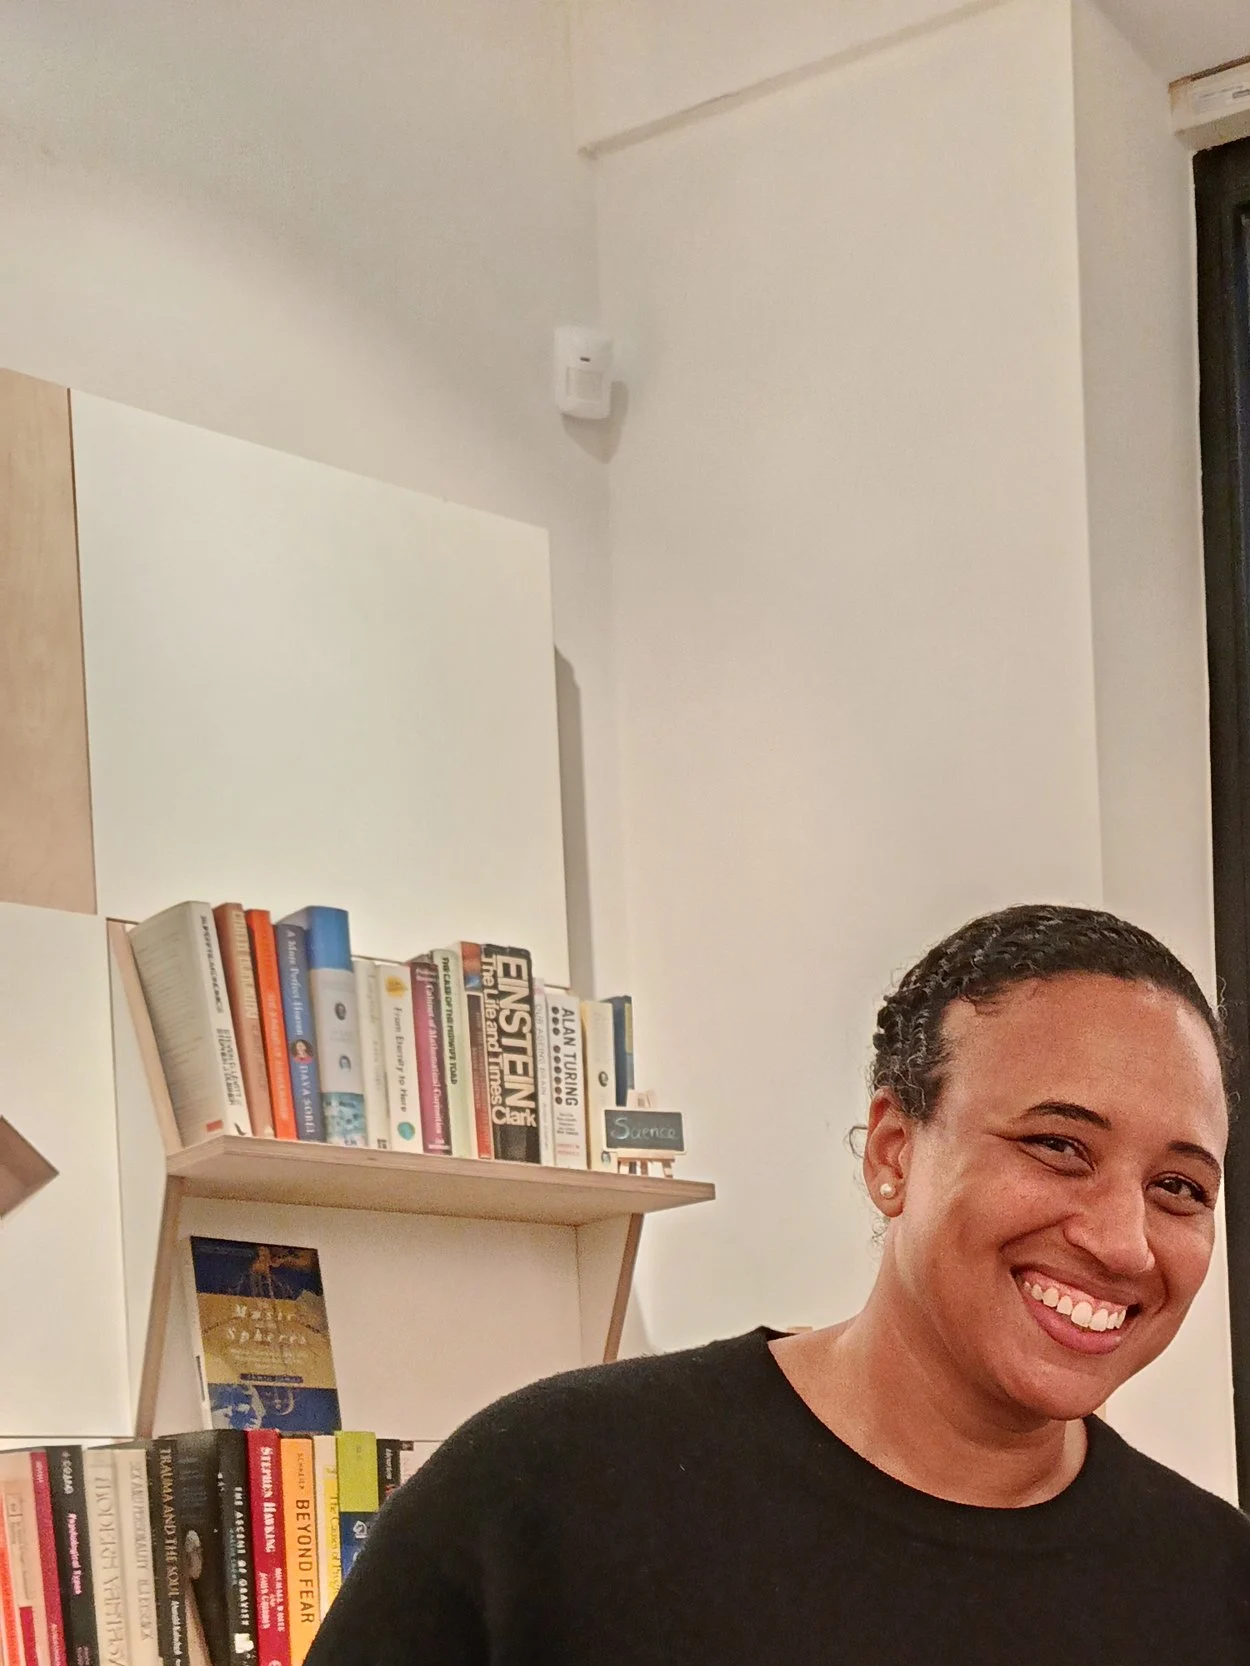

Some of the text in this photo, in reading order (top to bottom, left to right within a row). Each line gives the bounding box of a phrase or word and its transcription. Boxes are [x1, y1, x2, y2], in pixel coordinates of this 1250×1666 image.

[442, 957, 450, 972] THE
[443, 973, 452, 995] CASE
[445, 996, 453, 1008] OF
[393, 1007, 404, 1033] From
[481, 952, 504, 1105] The Life and Times
[497, 953, 536, 1109] EINSTEIN
[561, 1008, 577, 1047] ALAN
[395, 1036, 408, 1073] Eternity
[300, 1065, 312, 1096] DAVA
[399, 1075, 408, 1086] to
[564, 1053, 579, 1107] TURING
[491, 1106, 538, 1128] Clark
[610, 1116, 679, 1140] Science
[260, 1446, 278, 1553] STEPHEN HAWKING
[158, 1448, 181, 1597] TRAUMA AND THE SOUL
[296, 1499, 315, 1624] BEYOND FEAR
